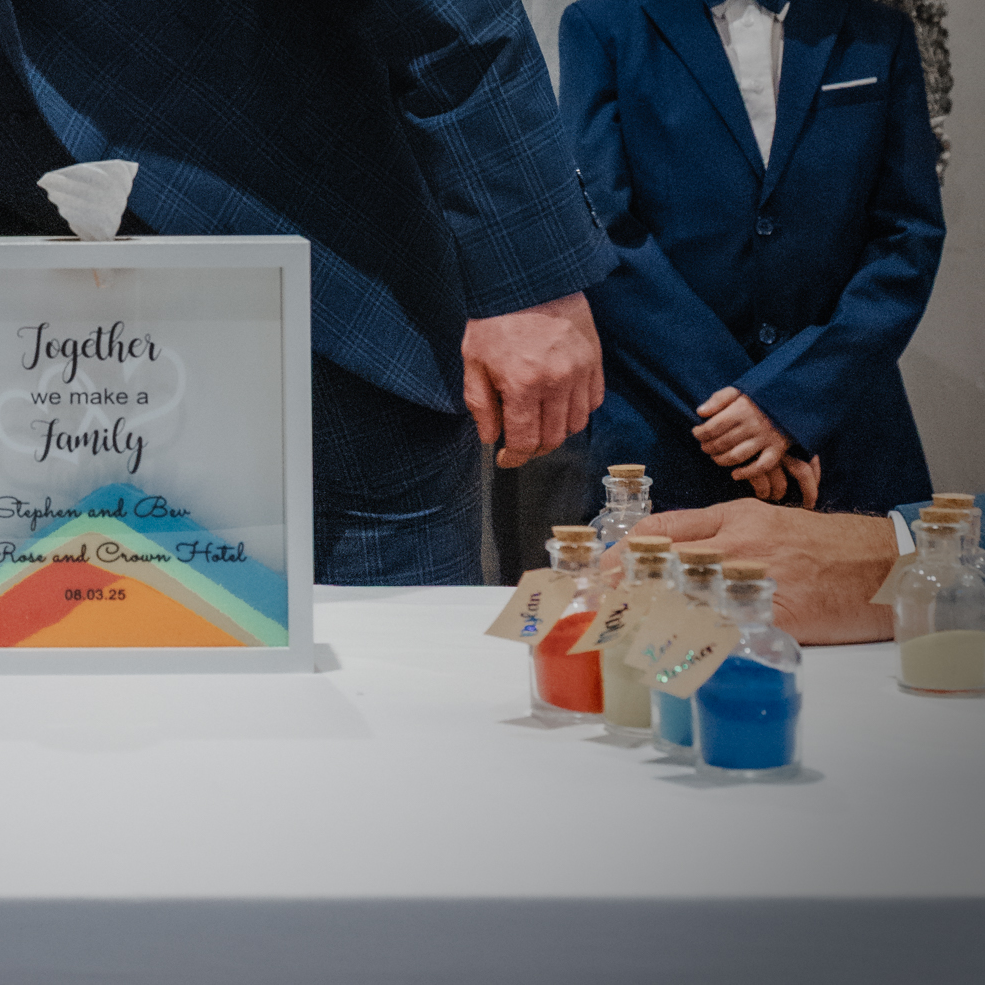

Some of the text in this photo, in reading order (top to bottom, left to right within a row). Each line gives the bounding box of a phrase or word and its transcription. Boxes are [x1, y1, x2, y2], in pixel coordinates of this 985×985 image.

[17, 321, 162, 384] Together
[30, 388, 150, 406] we make a
[30, 417, 149, 475] Family
[87, 497, 128, 519] and
[133, 495, 191, 519] Bev
[52, 543, 91, 564] and
[95, 541, 172, 564] Crown
[175, 541, 249, 564] Hotel
[64, 588, 127, 601] 08.03.25
